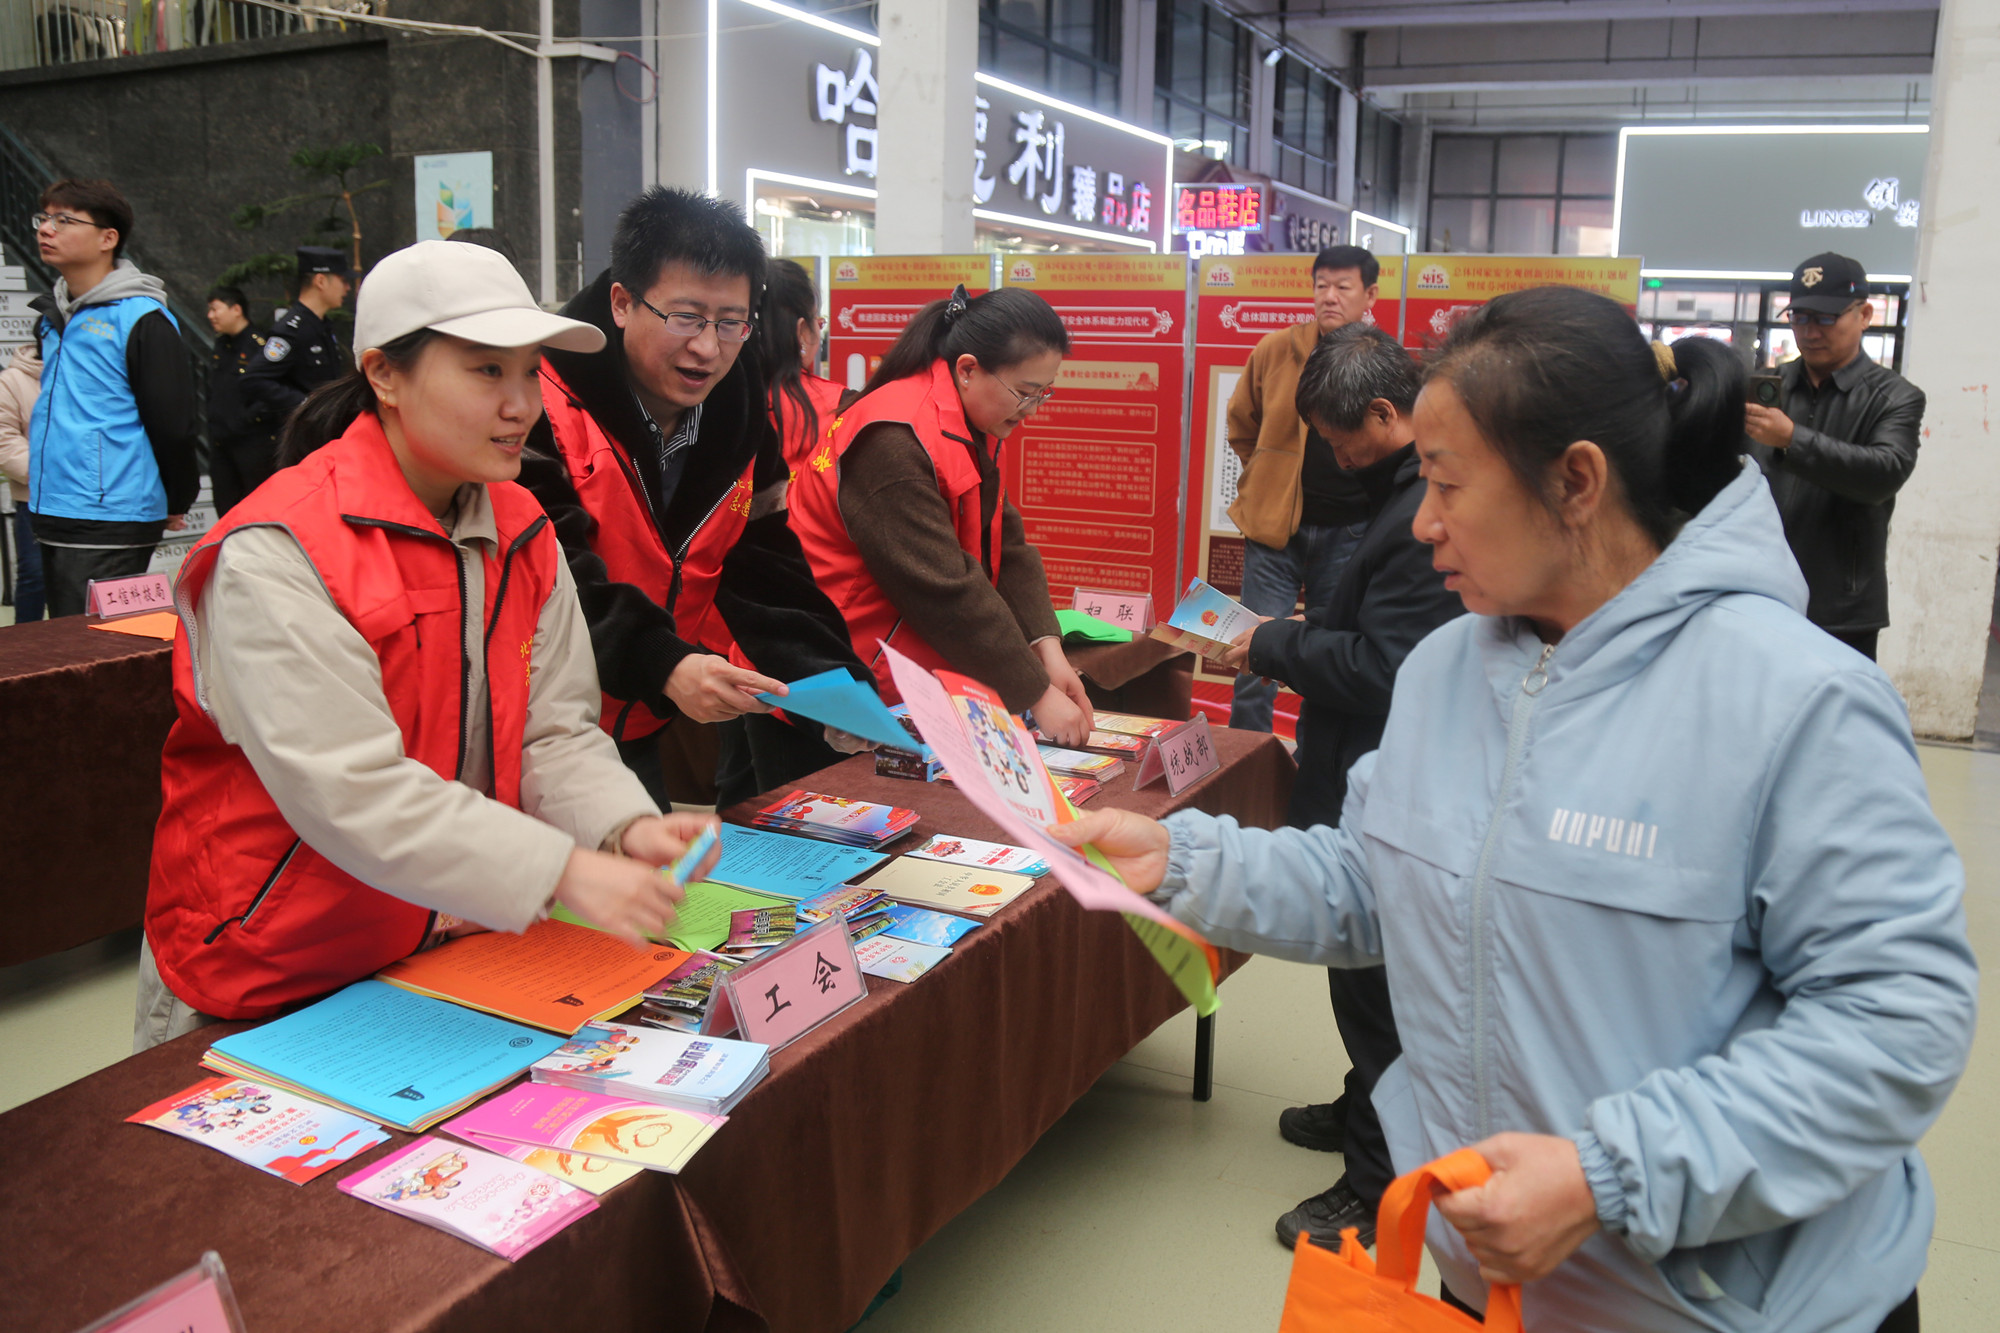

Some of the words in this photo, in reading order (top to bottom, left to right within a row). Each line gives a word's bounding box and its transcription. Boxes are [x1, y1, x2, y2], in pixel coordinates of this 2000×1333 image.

[1177, 187, 1261, 228] 名品鞋店
[1422, 268, 1444, 284] 415
[107, 582, 166, 605] 工信科技局
[1084, 601, 1134, 621] 妇联
[1169, 733, 1209, 776] 统战部
[765, 952, 842, 1023] 工会
